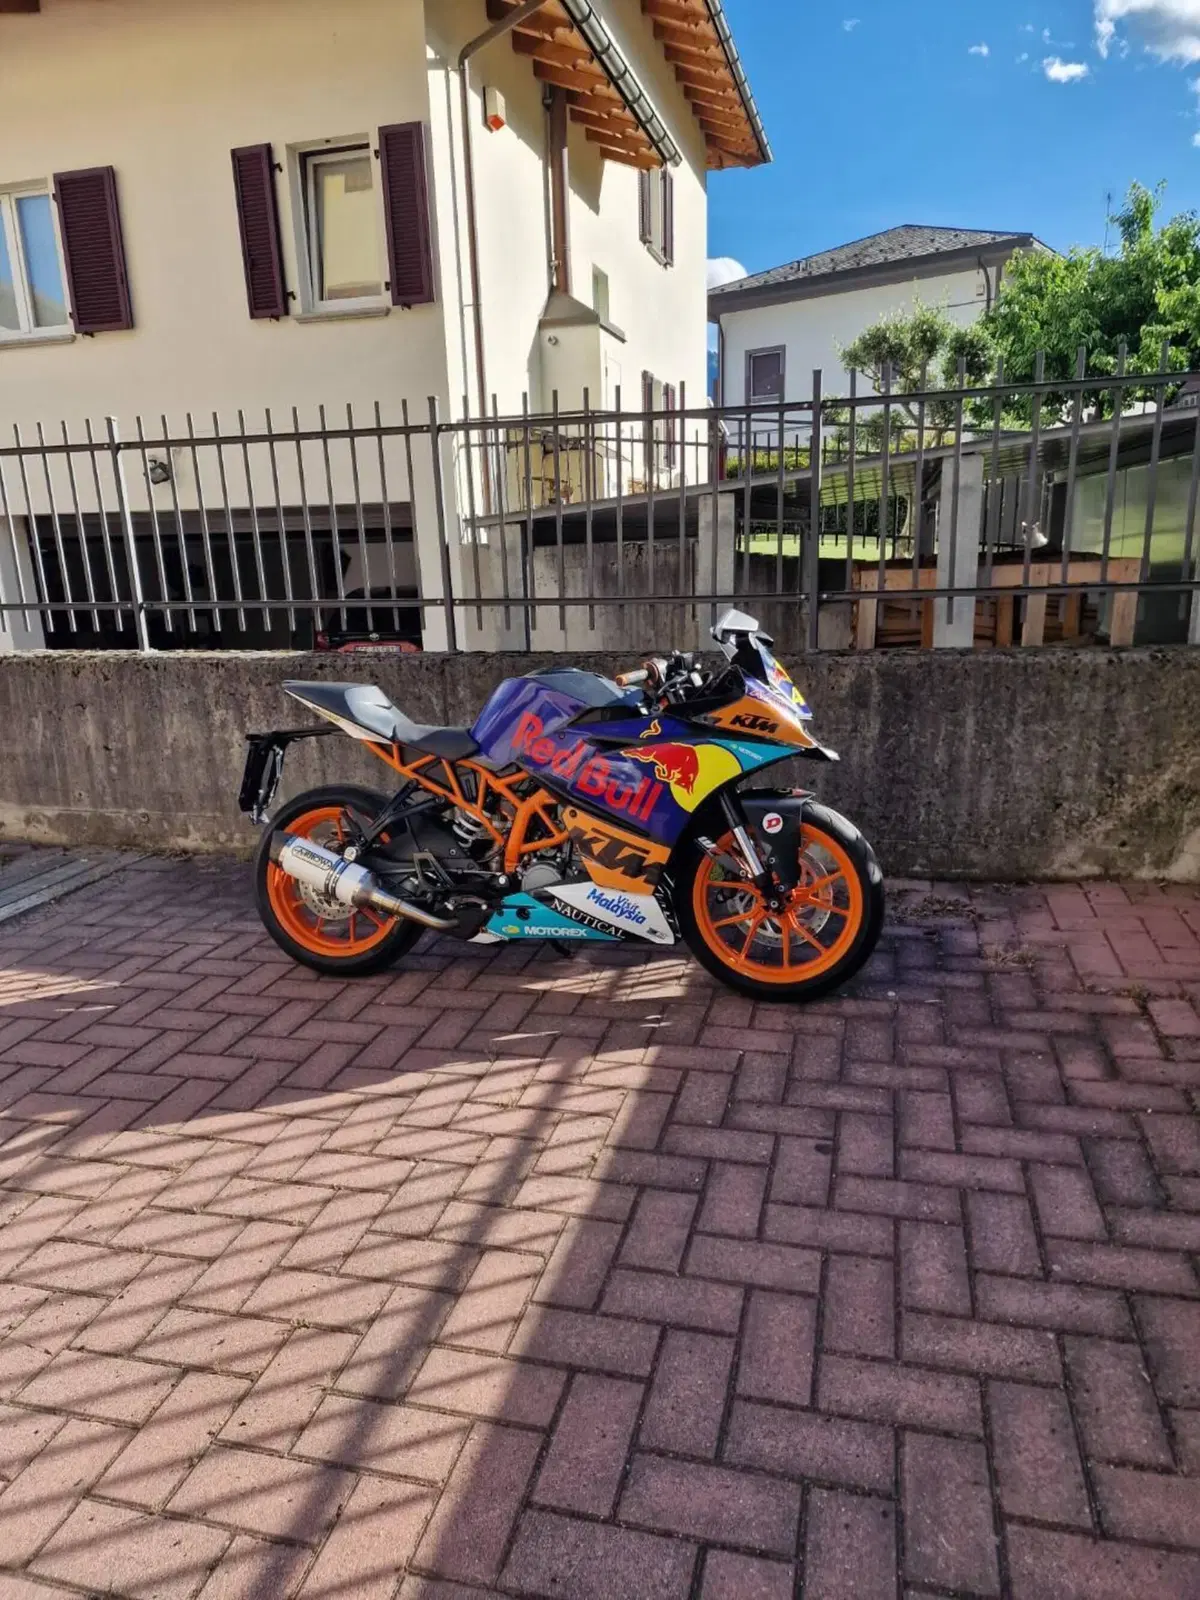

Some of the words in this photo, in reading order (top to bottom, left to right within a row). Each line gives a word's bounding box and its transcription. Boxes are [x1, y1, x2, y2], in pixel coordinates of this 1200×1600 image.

[729, 713, 779, 733] KTM
[511, 710, 586, 780] Red
[577, 752, 664, 821] Bull
[568, 825, 666, 888] KTM
[551, 898, 626, 939] NAUTICAL
[586, 888, 647, 925] Malaysia
[616, 895, 640, 912] Visit
[524, 925, 588, 937] MOTOREX
